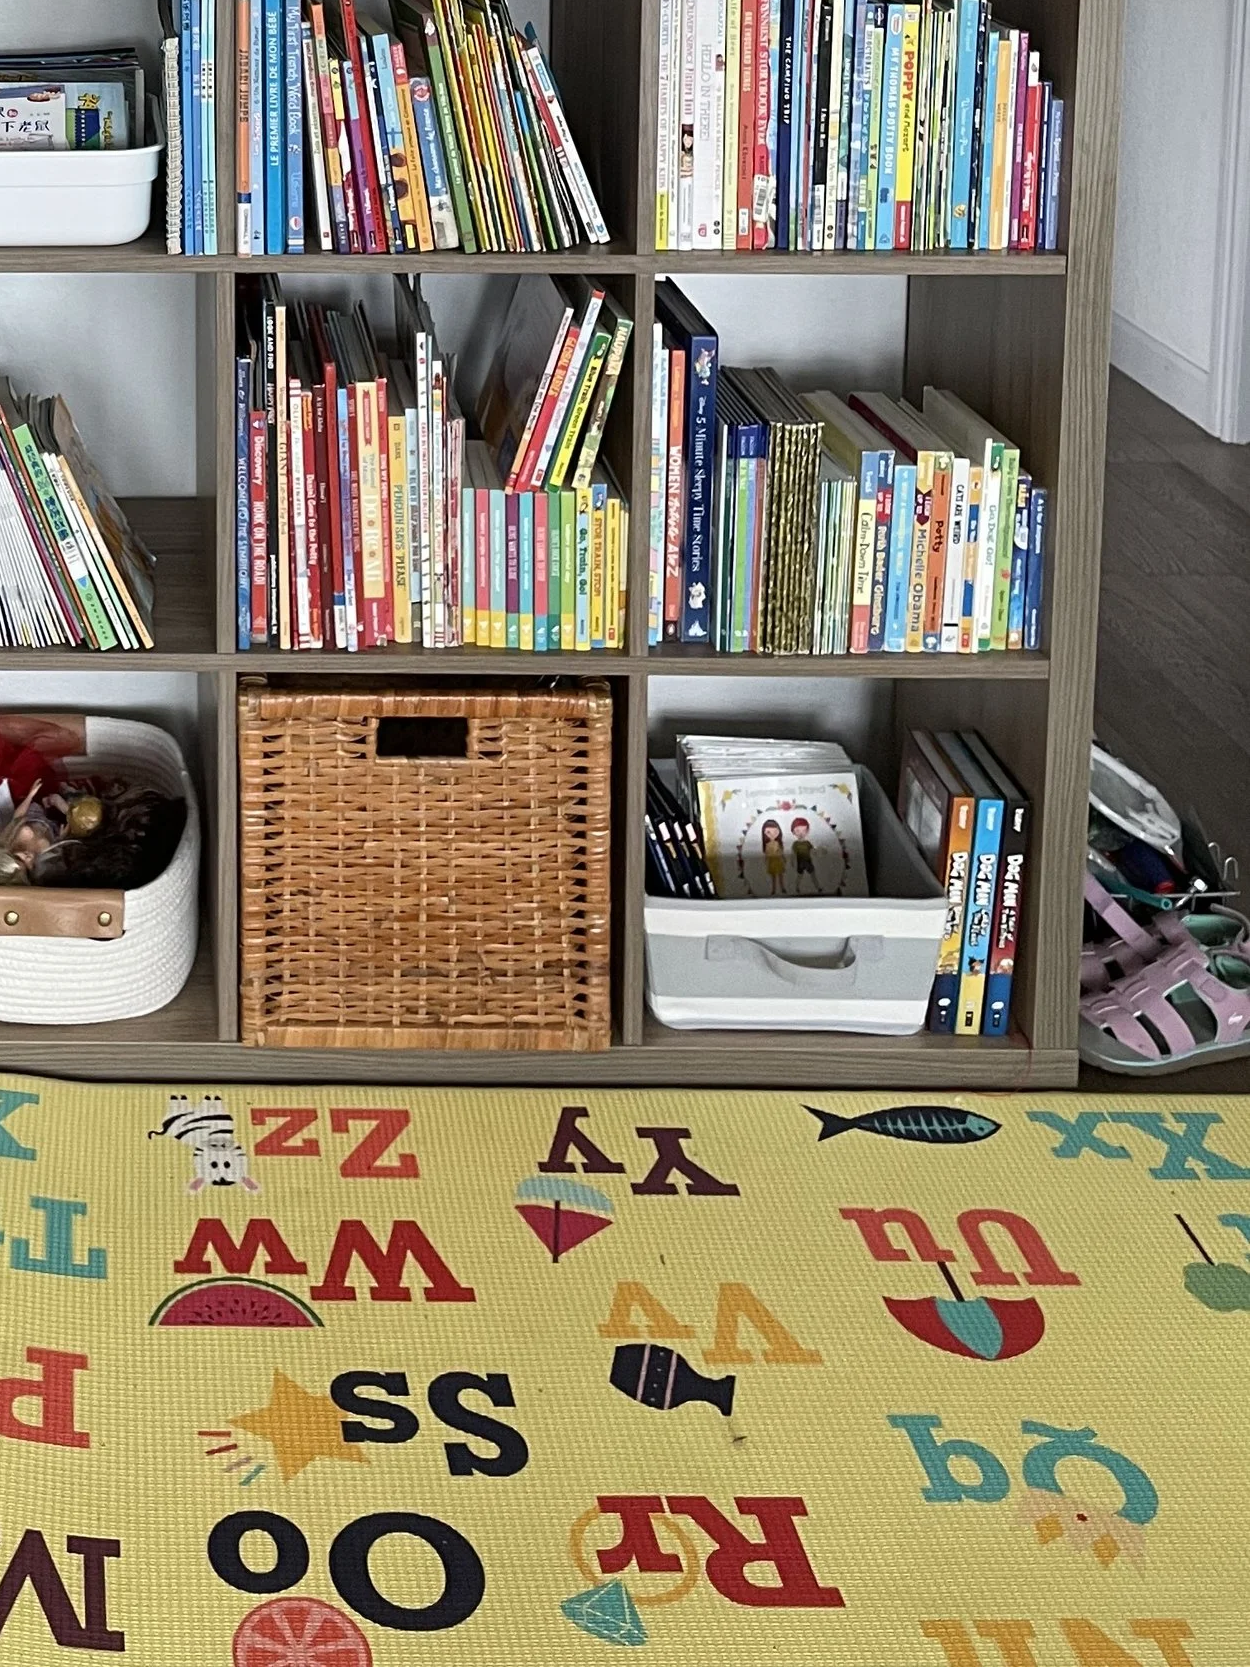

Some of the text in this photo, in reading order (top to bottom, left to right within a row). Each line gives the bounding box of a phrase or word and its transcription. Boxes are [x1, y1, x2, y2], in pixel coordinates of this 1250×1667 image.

[267, 11, 279, 166] LE PREMIER LIVRE DE MON BÉBÉ
[782, 36, 792, 125] THE CAMPING TRIP
[902, 51, 915, 101] POPPY
[883, 47, 899, 174] MY THOMAS POTTY BOOK
[253, 436, 265, 485] Discovery
[253, 502, 266, 585] HONK ON THE ROAD!
[577, 528, 587, 595] Go, Train, Go!
[932, 521, 944, 553] Potty
[911, 529, 927, 632] Michelle Obama
[976, 854, 996, 881] DOG
[1004, 854, 1023, 880] DOG
